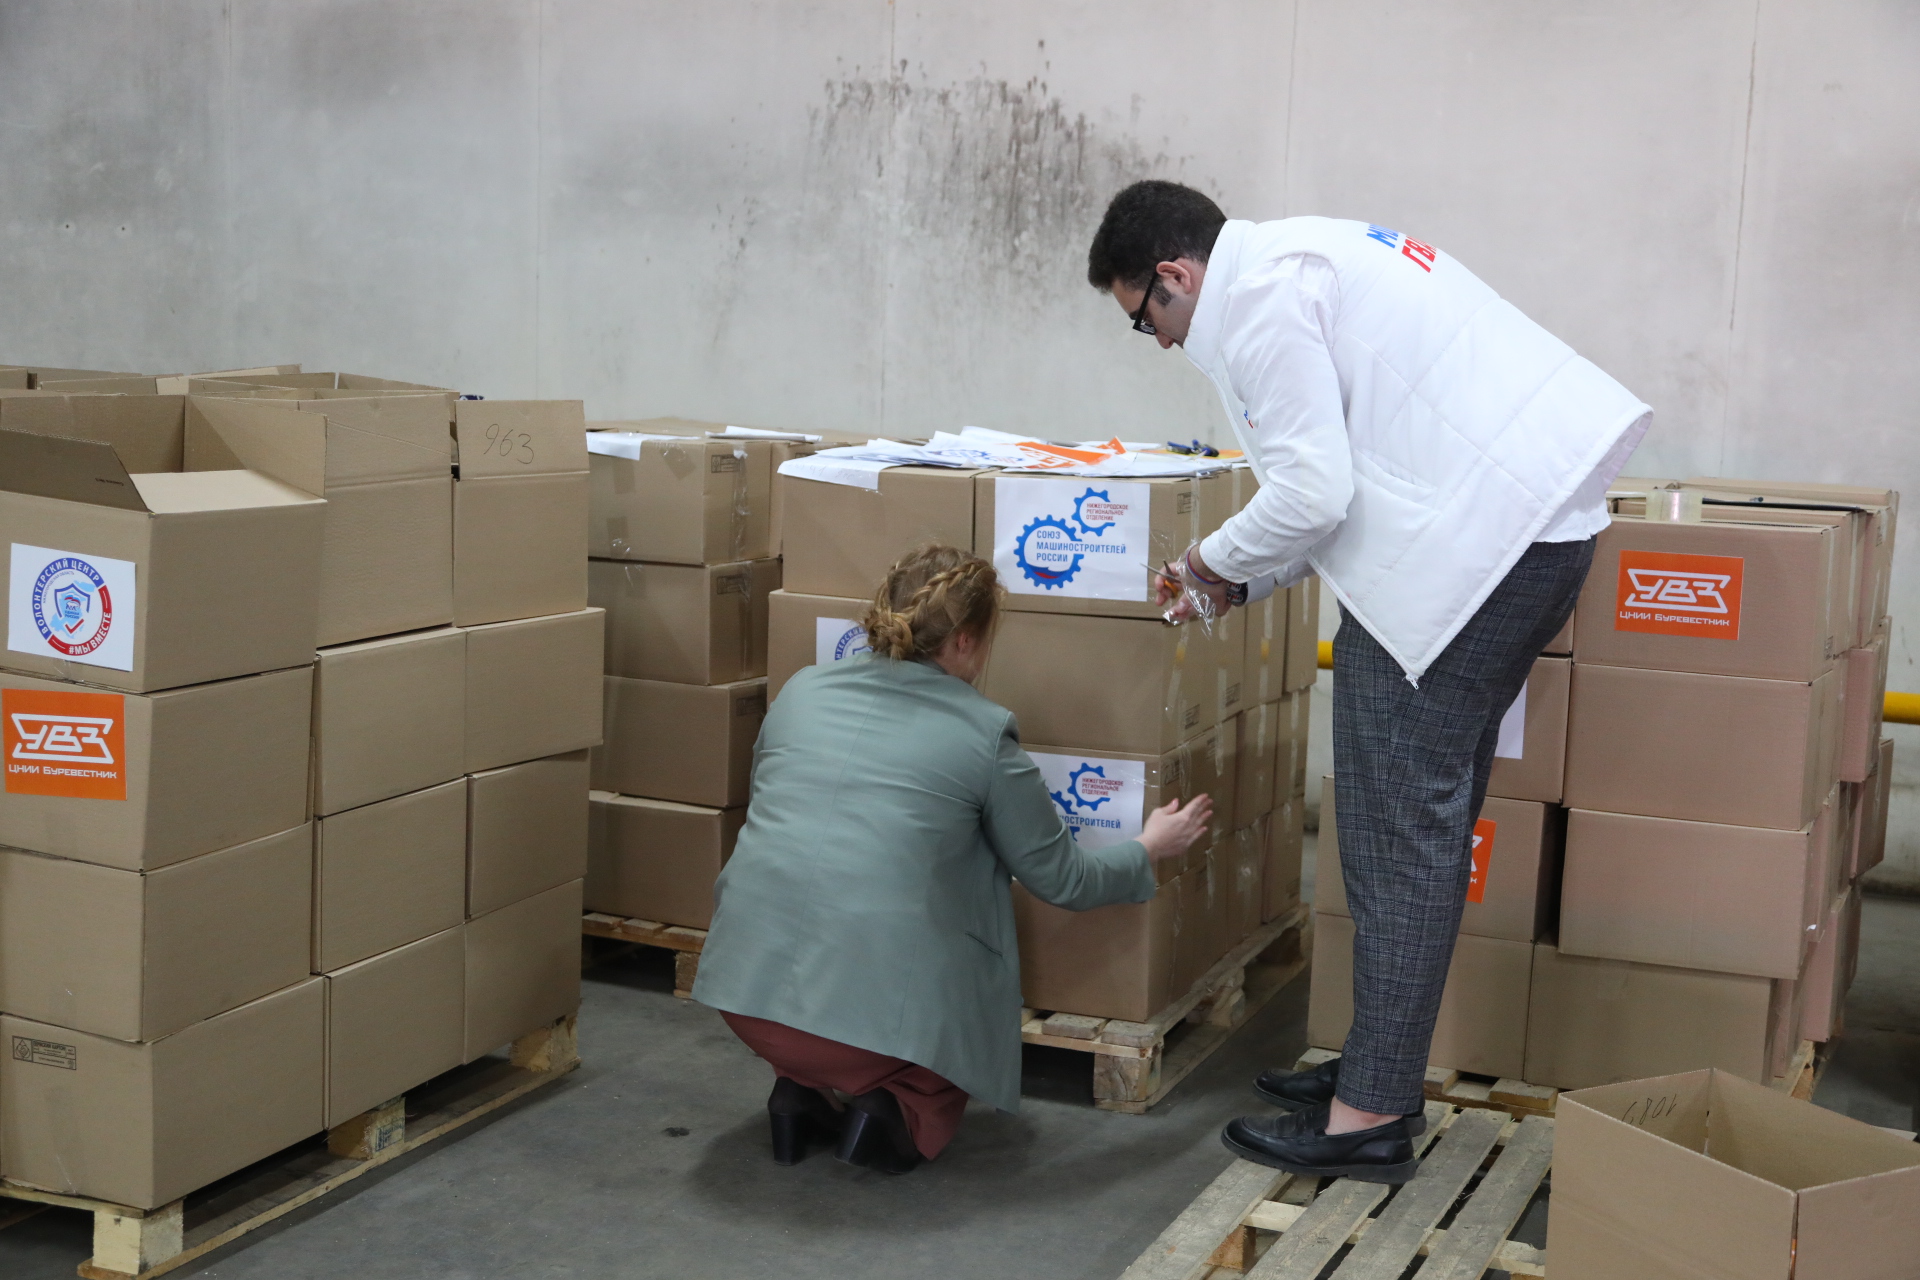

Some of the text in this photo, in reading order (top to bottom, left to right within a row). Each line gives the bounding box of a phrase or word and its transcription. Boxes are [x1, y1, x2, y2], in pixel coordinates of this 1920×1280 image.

[483, 423, 535, 465] 963
[1036, 530, 1061, 540] СОЮЗ
[1036, 541, 1126, 554] МАШИНОСТРОИТЕЛЕЙ
[1036, 552, 1068, 562] РОССИИ
[34, 558, 100, 634] ВОЛОНТЕРСКИЙ ЦЕНТР
[1619, 611, 1730, 626] ЦНИИ БУРЕВЕСТНИК
[8, 764, 117, 779] ЦНИИ БУРЕВЕСТНИК
[1063, 815, 1121, 829] ОСТРОИТЕЛЕЙ
